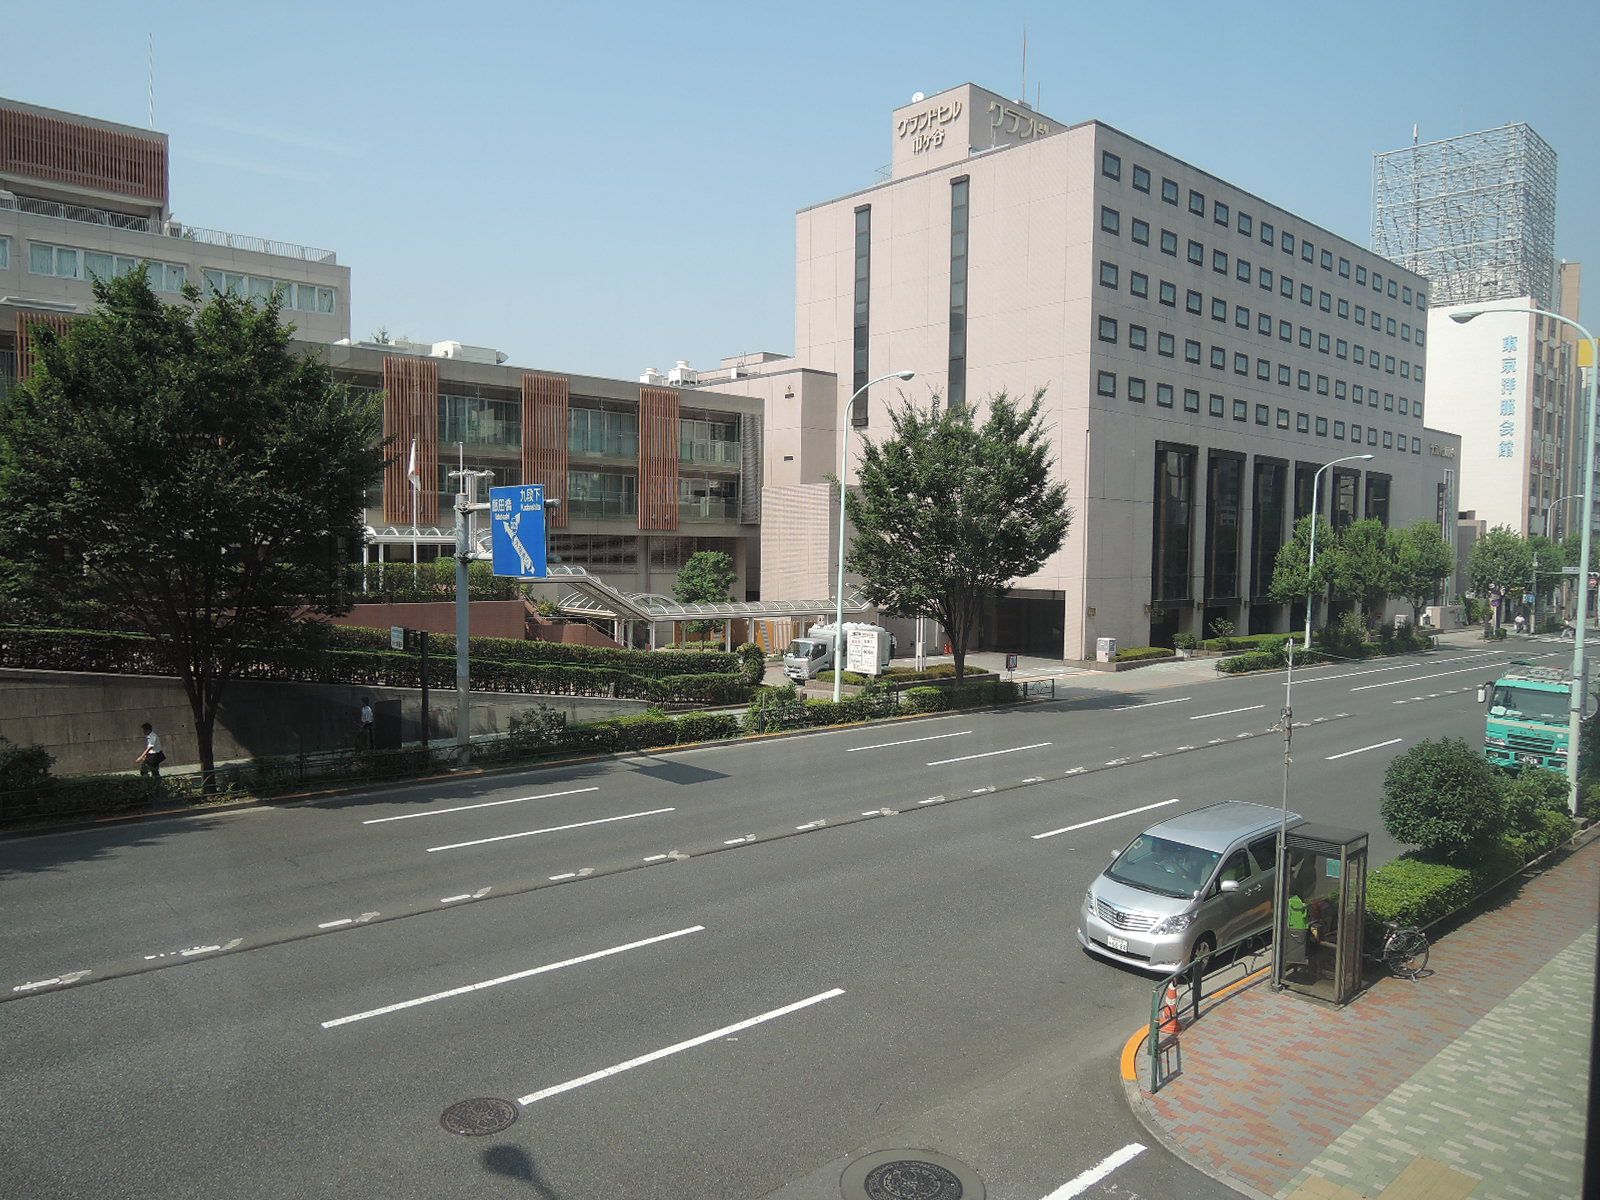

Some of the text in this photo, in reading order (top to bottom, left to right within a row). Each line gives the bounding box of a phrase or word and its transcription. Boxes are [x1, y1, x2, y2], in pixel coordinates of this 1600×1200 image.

[898, 100, 962, 138] グランドヒル
[988, 100, 1050, 138] グランド
[1499, 335, 1518, 458] 東京洋服会館
[492, 498, 512, 512] 飯田橋
[520, 488, 541, 502] 九段下
